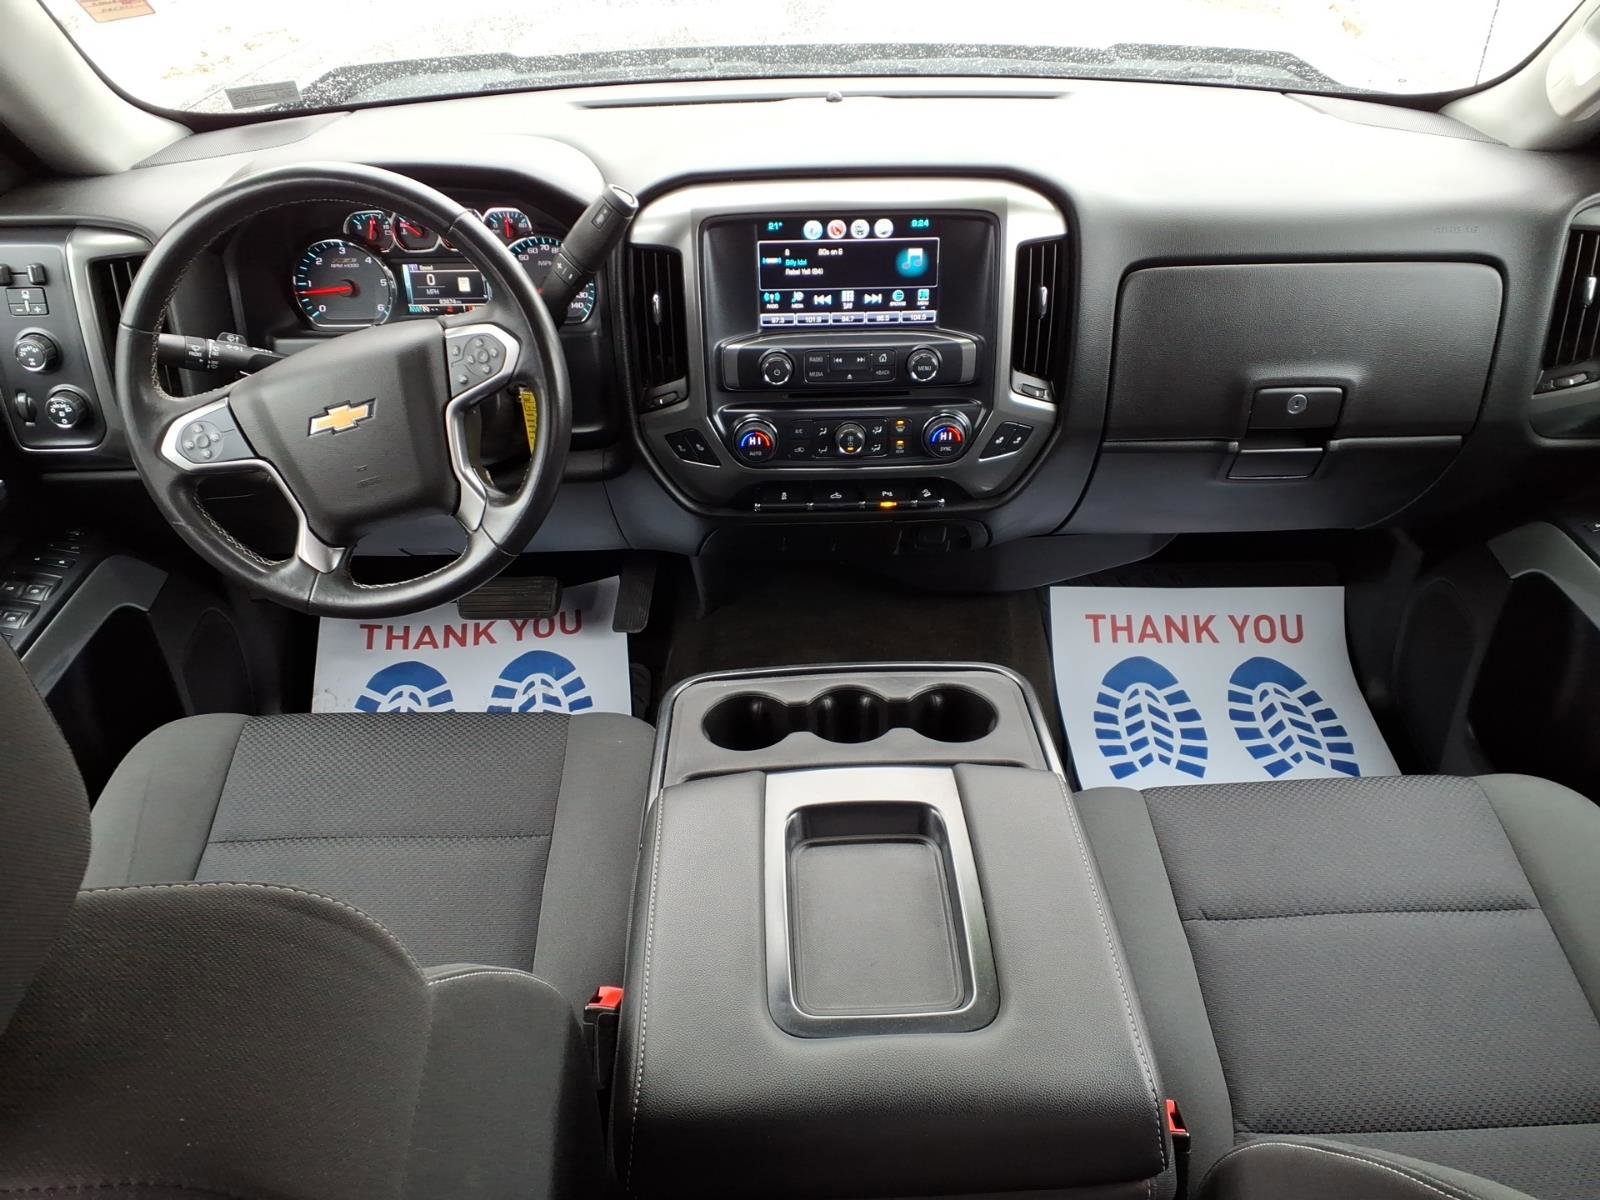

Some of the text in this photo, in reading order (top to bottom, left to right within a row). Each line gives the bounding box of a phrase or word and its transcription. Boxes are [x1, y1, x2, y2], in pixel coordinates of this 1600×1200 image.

[315, 257, 323, 265] 2
[364, 256, 372, 264] 4
[426, 273, 436, 286] 0
[318, 304, 326, 312] 0
[377, 303, 385, 311] 6
[749, 436, 761, 446] HI
[940, 431, 952, 441] HI
[359, 609, 583, 650] THANK YOU
[1085, 614, 1304, 644] THANK YOU
